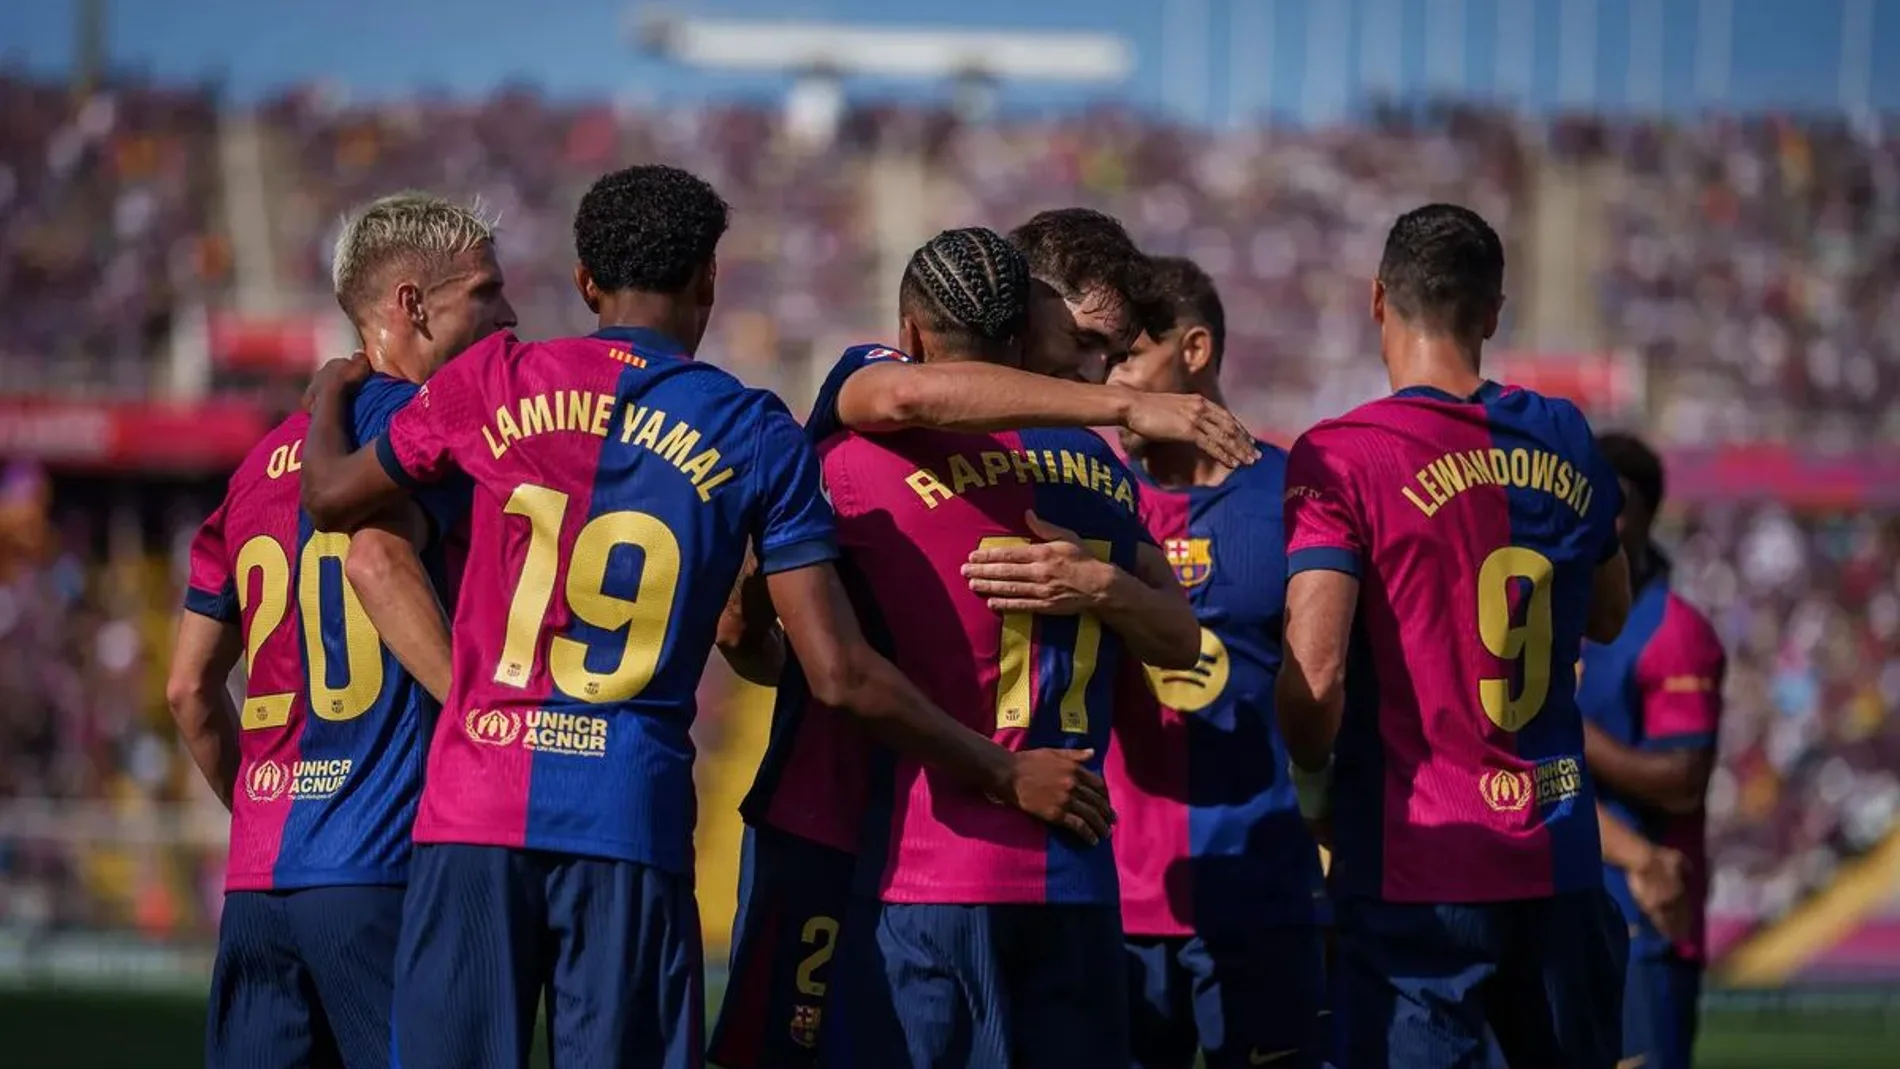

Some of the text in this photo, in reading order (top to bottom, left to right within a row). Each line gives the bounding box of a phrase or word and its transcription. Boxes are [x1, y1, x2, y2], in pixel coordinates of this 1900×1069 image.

[267, 439, 302, 479] OL
[481, 390, 734, 502] LAMINE YAMAL
[905, 450, 1135, 509] RAPHINHA
[1401, 447, 1593, 518] LEWANDOWSKI
[494, 483, 681, 703] 19
[236, 531, 383, 731] 20
[1478, 546, 1553, 732] 9
[522, 728, 606, 751] ACNUR
[526, 710, 608, 737] UNHCR
[292, 759, 352, 777] UNHCR
[794, 916, 840, 996] 2
